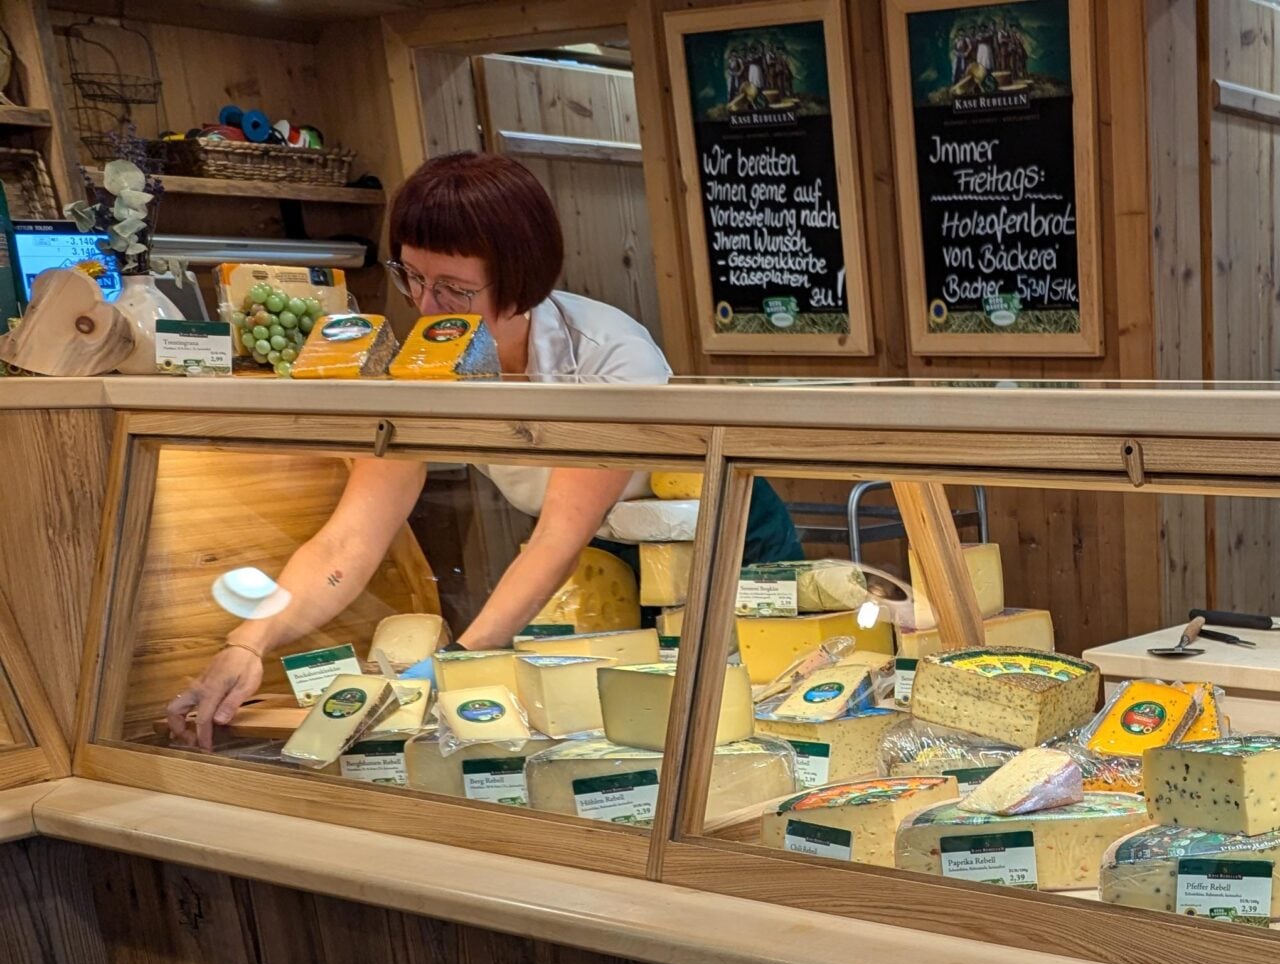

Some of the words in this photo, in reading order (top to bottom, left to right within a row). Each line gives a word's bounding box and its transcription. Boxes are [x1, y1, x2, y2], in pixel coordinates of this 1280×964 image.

[703, 144, 732, 176] Wir
[737, 147, 800, 177] bereiten
[793, 177, 822, 215] auf
[953, 164, 1045, 201] Freitags:
[710, 205, 797, 236] Vorbestellung
[801, 200, 840, 229] nach
[941, 203, 1075, 243] Holzofenbrot
[753, 227, 812, 254] Wunsch
[942, 246, 975, 270] von
[942, 274, 1004, 303] Bacher
[948, 857, 973, 867] Paprika
[975, 856, 996, 865] Rebell
[1009, 874, 1026, 882] 2,39
[1186, 882, 1209, 890] Pfeffer
[1210, 882, 1231, 891] Rebell
[1241, 905, 1257, 913] 2,39
